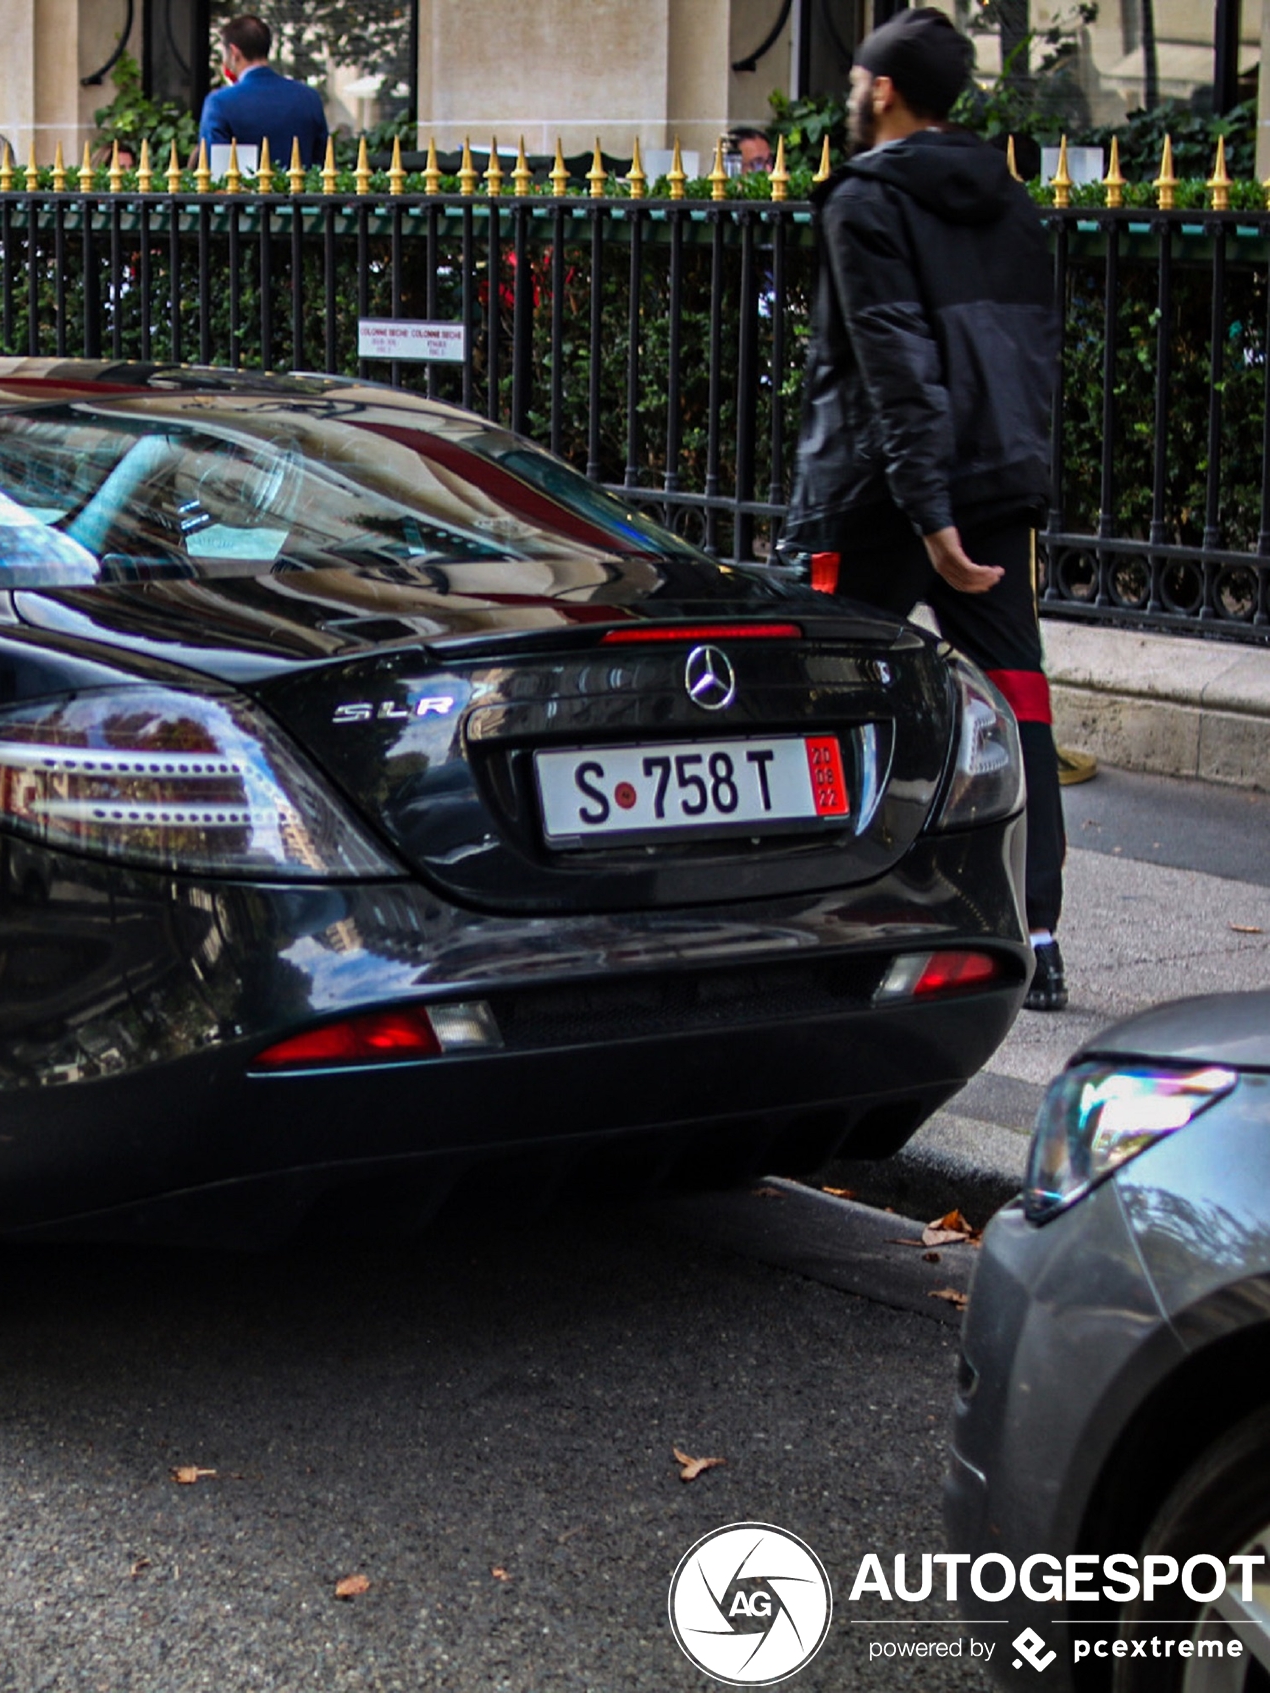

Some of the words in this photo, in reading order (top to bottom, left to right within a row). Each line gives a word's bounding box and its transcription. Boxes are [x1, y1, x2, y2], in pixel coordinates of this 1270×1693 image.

[332, 697, 454, 723] SLR
[811, 747, 831, 765] 20
[815, 767, 834, 785] 08
[574, 761, 610, 825] S
[642, 751, 739, 819] 758
[746, 750, 774, 811] T
[818, 788, 838, 807] 22
